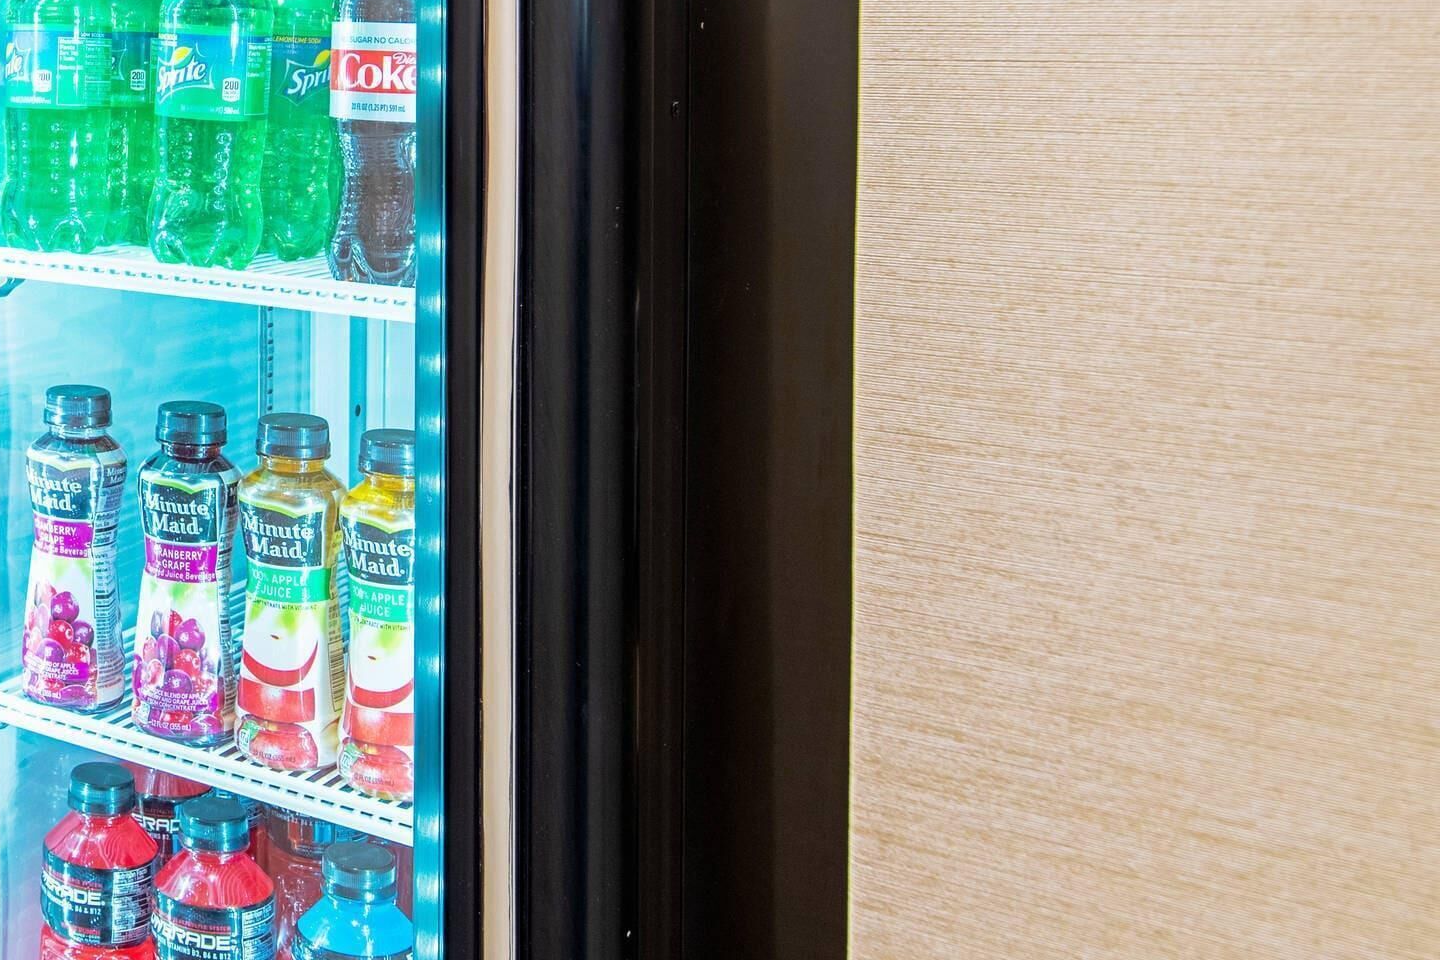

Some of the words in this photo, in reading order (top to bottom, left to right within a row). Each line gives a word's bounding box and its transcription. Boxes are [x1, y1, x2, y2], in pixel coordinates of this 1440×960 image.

[131, 71, 145, 80] 200
[338, 53, 417, 91] Coke
[224, 81, 239, 90] 200
[146, 492, 209, 516] Minute
[243, 511, 314, 541] Minute
[342, 526, 411, 557] Minute
[162, 558, 191, 572] GRAPE
[262, 584, 292, 598] JUICE
[371, 591, 405, 606] APPLE
